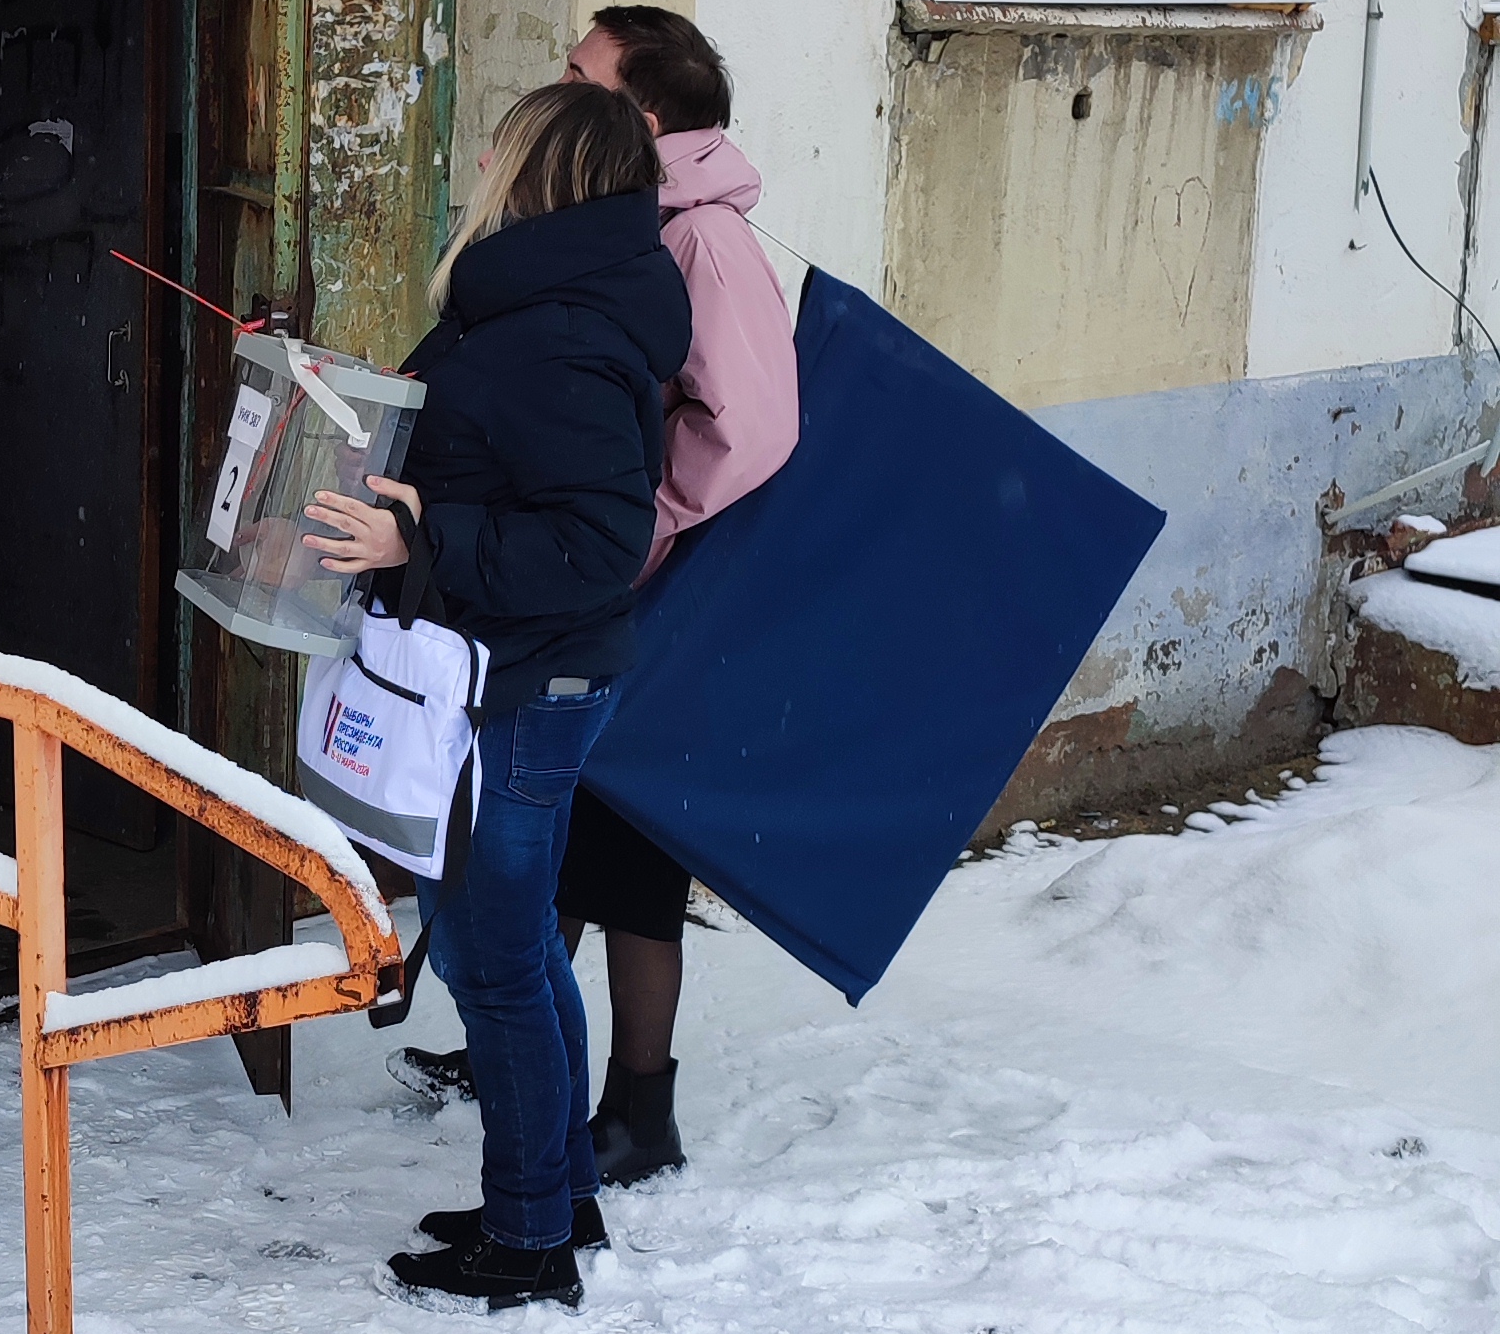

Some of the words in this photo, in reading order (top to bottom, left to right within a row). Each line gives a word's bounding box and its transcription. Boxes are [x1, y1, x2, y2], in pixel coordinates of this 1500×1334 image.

[220, 465, 239, 513] 2
[342, 706, 375, 728] ВЫБОРЫ
[332, 735, 360, 757] РОССИИ
[337, 721, 383, 750] ПРЕЗИДЕНТА
